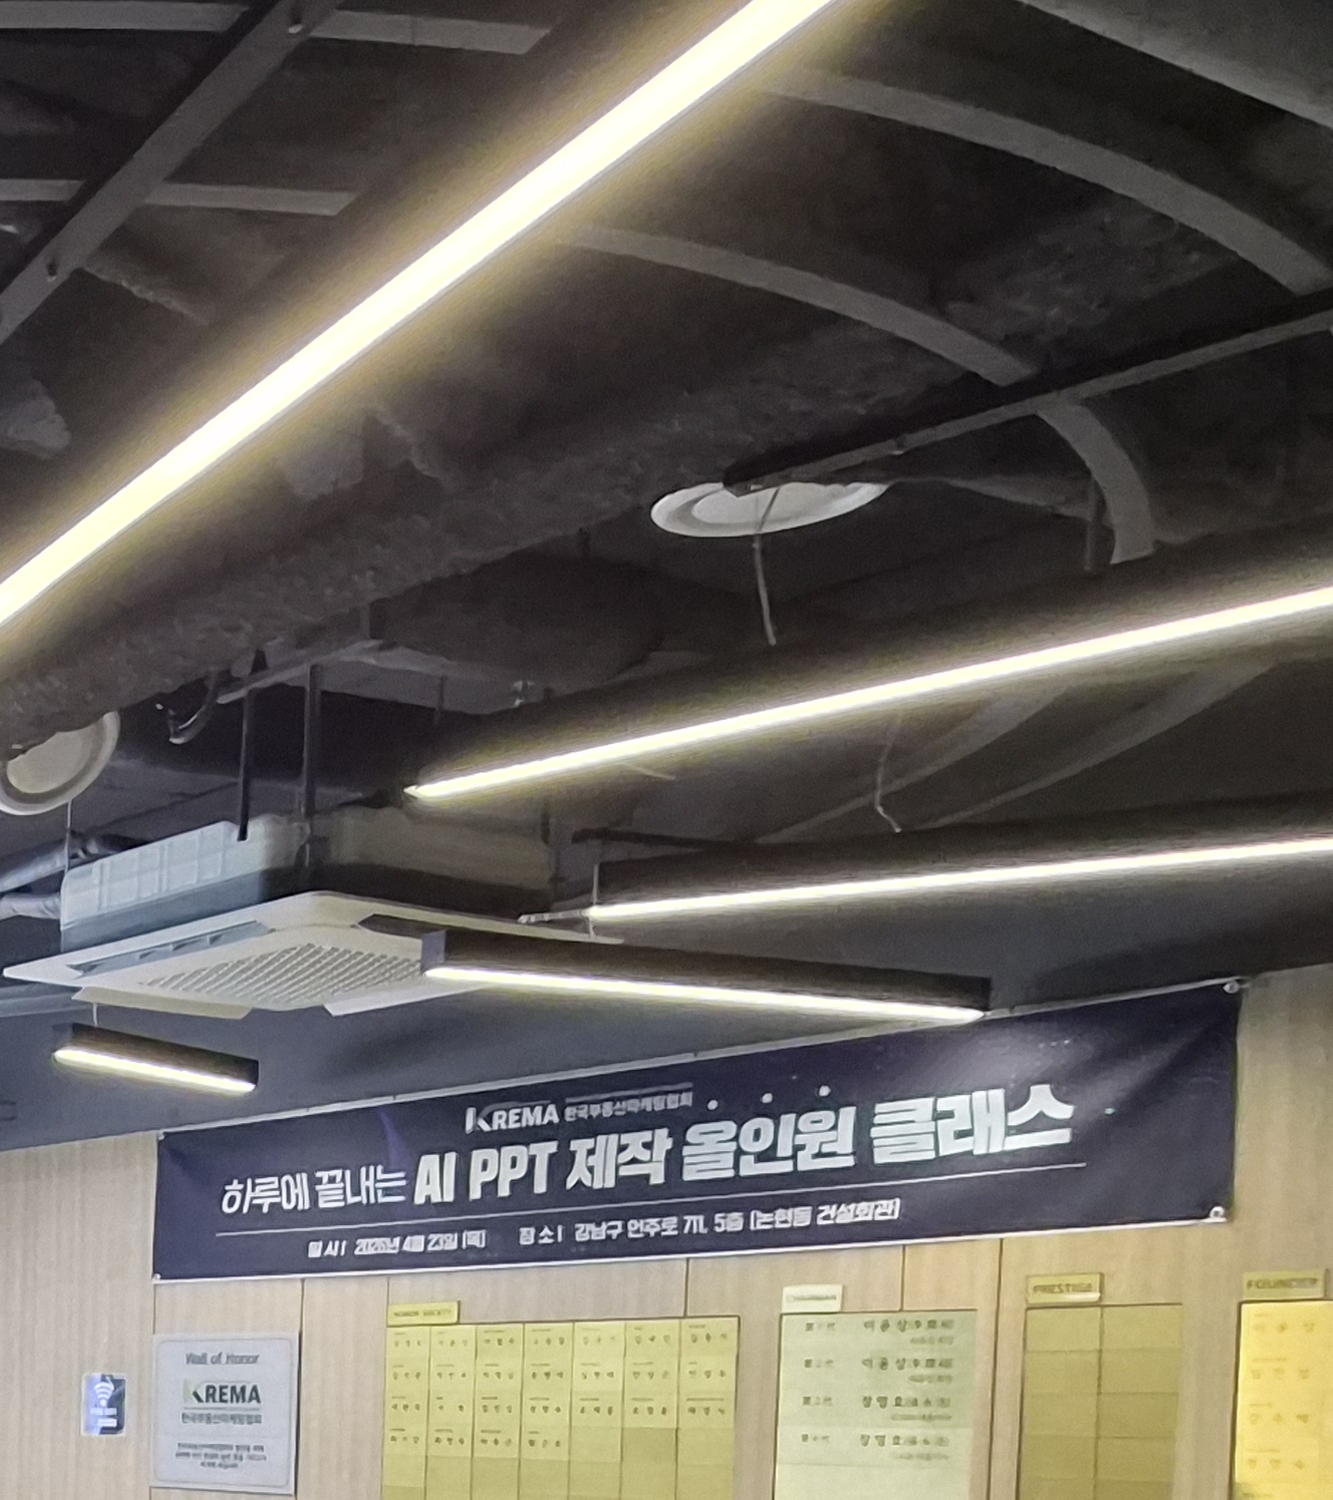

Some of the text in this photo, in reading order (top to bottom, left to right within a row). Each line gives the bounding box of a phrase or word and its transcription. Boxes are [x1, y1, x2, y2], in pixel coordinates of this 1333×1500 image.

[465, 1105, 559, 1133] KREMA
[222, 1084, 1074, 1214] 하루에 끝내는 AI PPT 제작 올인원 클래스
[574, 1221, 624, 1242] 강남구
[627, 1216, 678, 1238] 언주로
